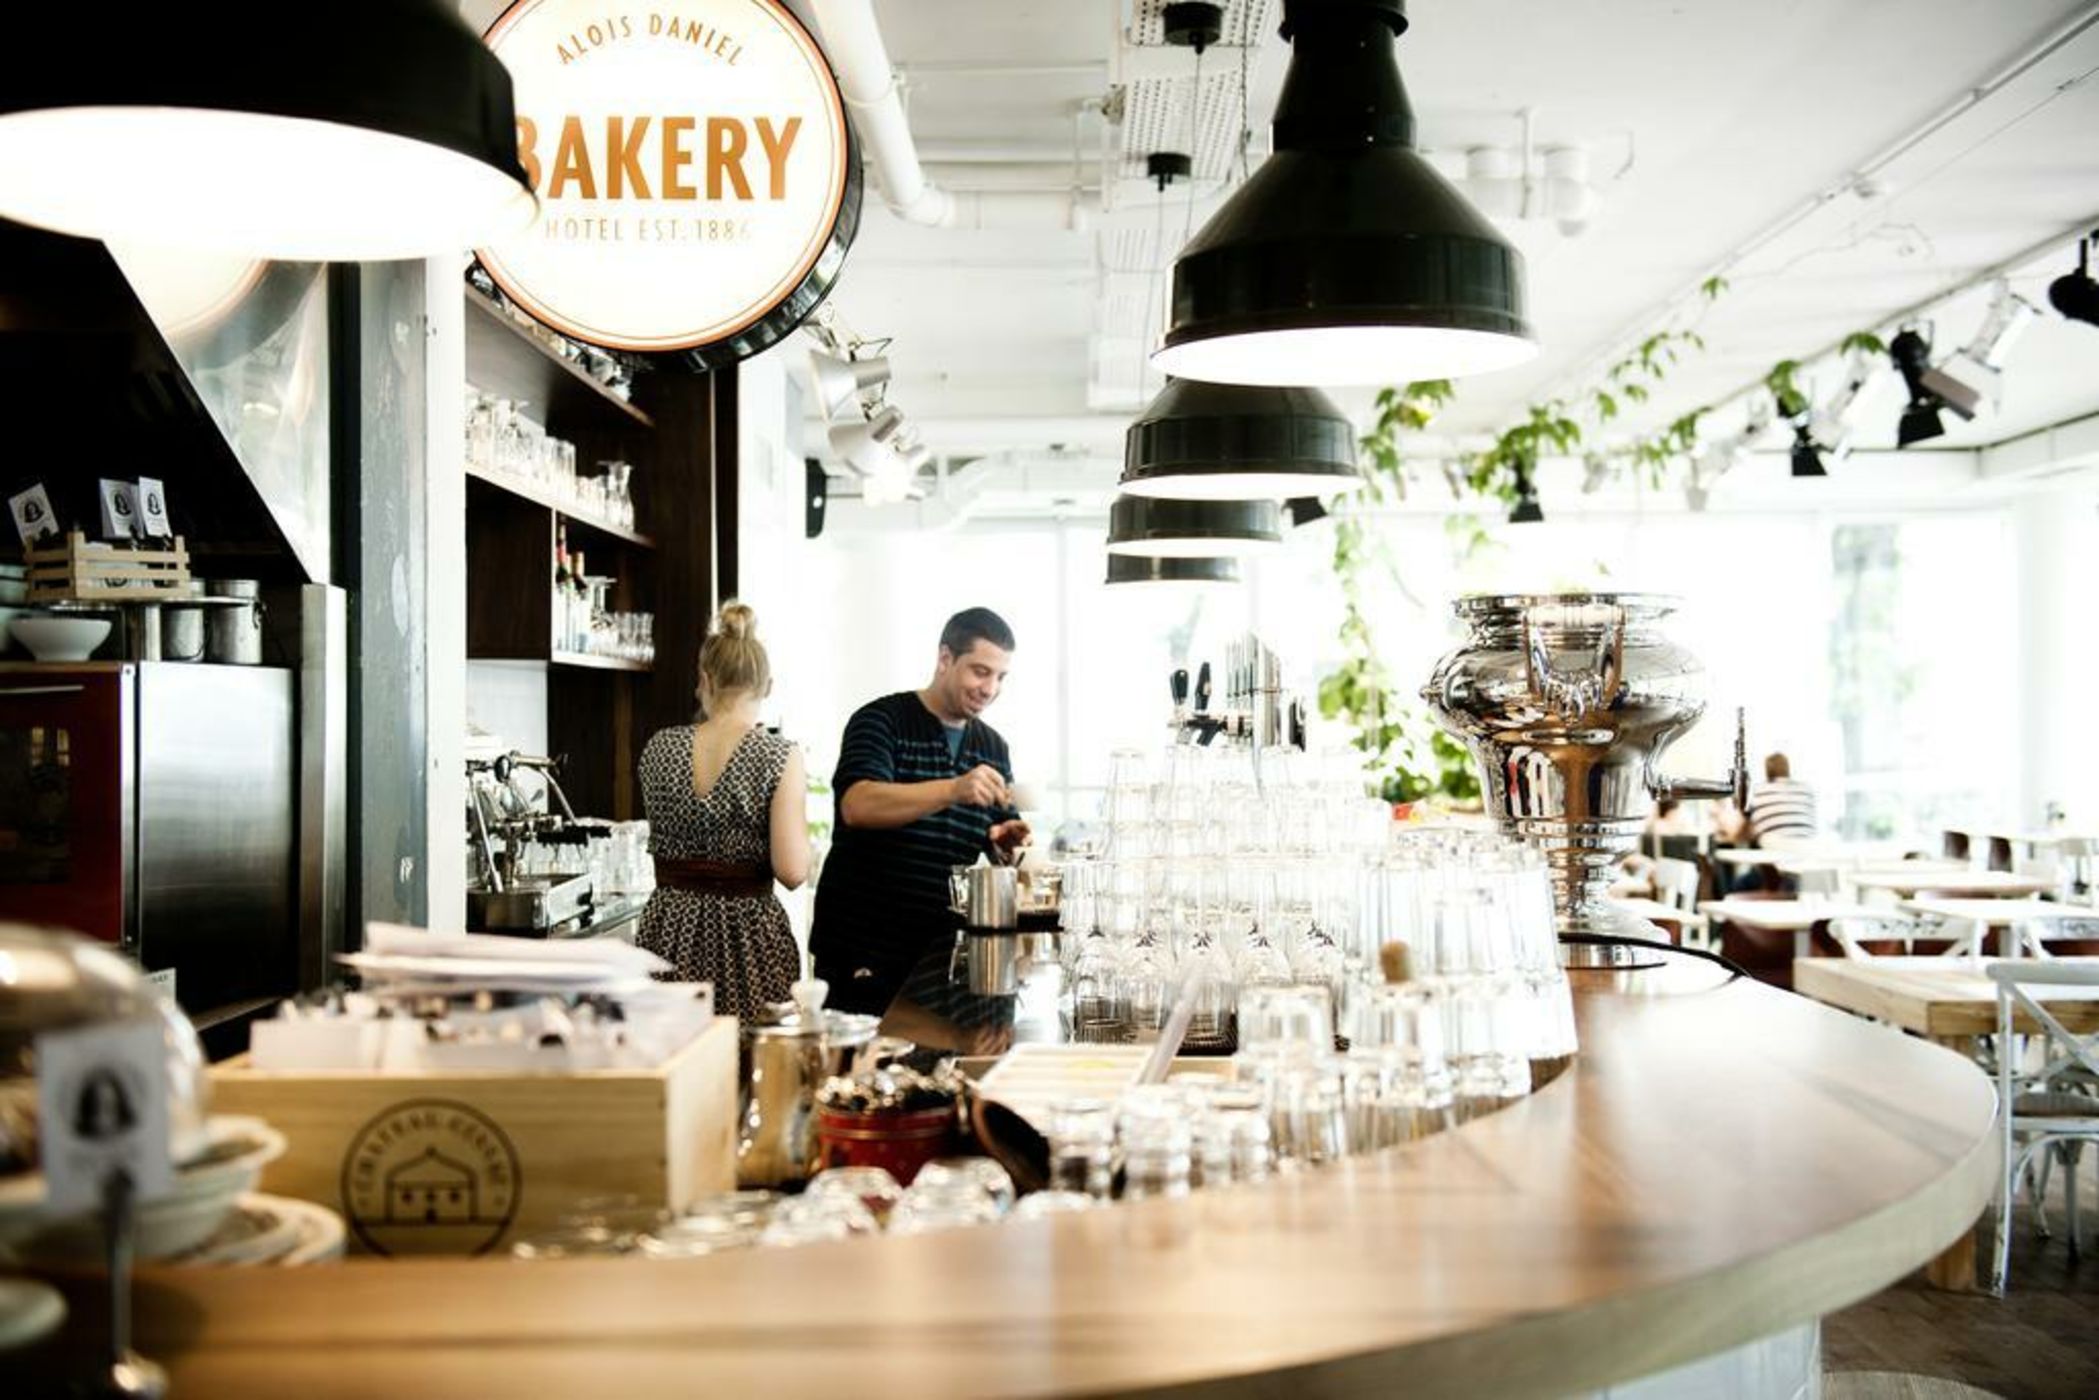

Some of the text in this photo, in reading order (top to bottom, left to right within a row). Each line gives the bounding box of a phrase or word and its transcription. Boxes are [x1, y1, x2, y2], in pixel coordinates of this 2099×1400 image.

[556, 13, 743, 66] ALOIS DANIEL
[545, 218, 624, 241] HOTEL
